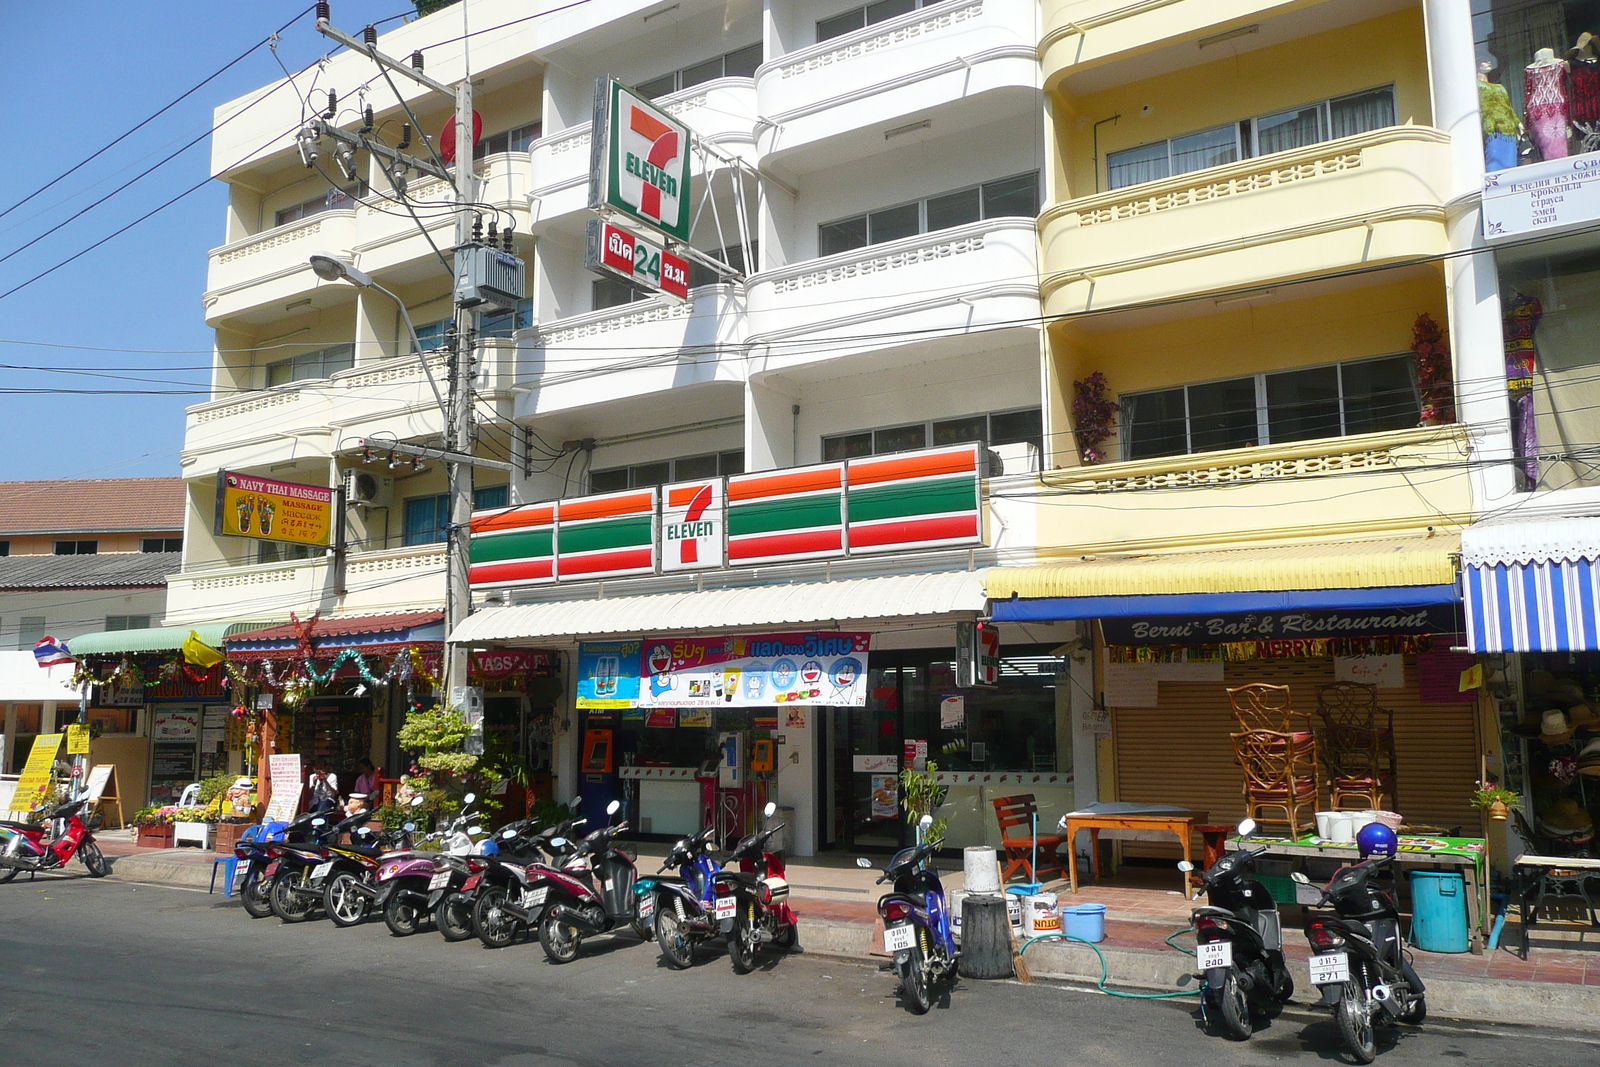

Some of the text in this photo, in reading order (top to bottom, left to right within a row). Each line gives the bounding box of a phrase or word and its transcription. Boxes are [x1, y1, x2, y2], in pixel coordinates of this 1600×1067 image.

[629, 104, 678, 221] 7
[1510, 179, 1550, 193] Изделия
[1531, 182, 1582, 199] крокодила
[1531, 195, 1564, 209] страуса
[1532, 214, 1558, 226] ската
[608, 232, 634, 262] เปิด
[634, 244, 661, 282] 24
[240, 479, 331, 502] NAVY THAI MASSAGE
[282, 500, 323, 511] MASSAGE
[668, 484, 713, 564] 7
[1131, 610, 1428, 639] Berni Bar & Restaurant
[1256, 637, 1315, 659] MERRY
[893, 941, 909, 949] 105
[1205, 958, 1223, 967] 240
[1319, 971, 1338, 981] 271
